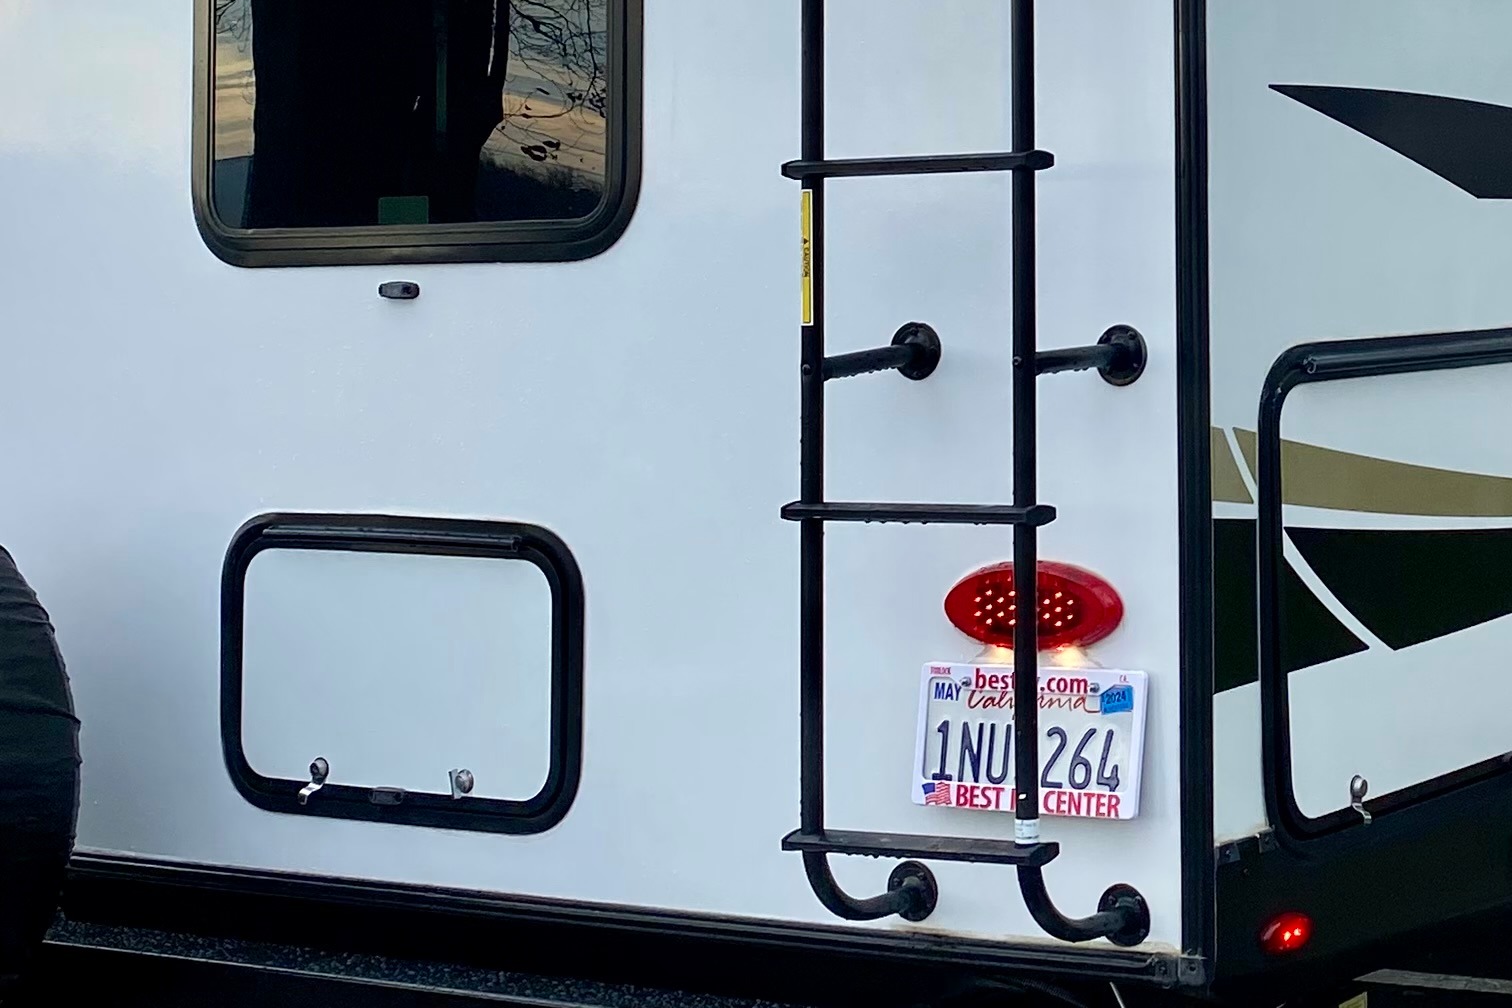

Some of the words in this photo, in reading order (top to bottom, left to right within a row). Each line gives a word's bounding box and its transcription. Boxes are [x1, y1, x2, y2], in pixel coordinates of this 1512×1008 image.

[934, 682, 962, 701] MAY
[975, 668, 1088, 693] best.com
[967, 689, 1101, 719] Calirnia
[1105, 691, 1127, 704] 2024
[932, 720, 1120, 792] 1NU264
[956, 784, 1006, 809] BEST
[1043, 790, 1121, 818] CENTER
